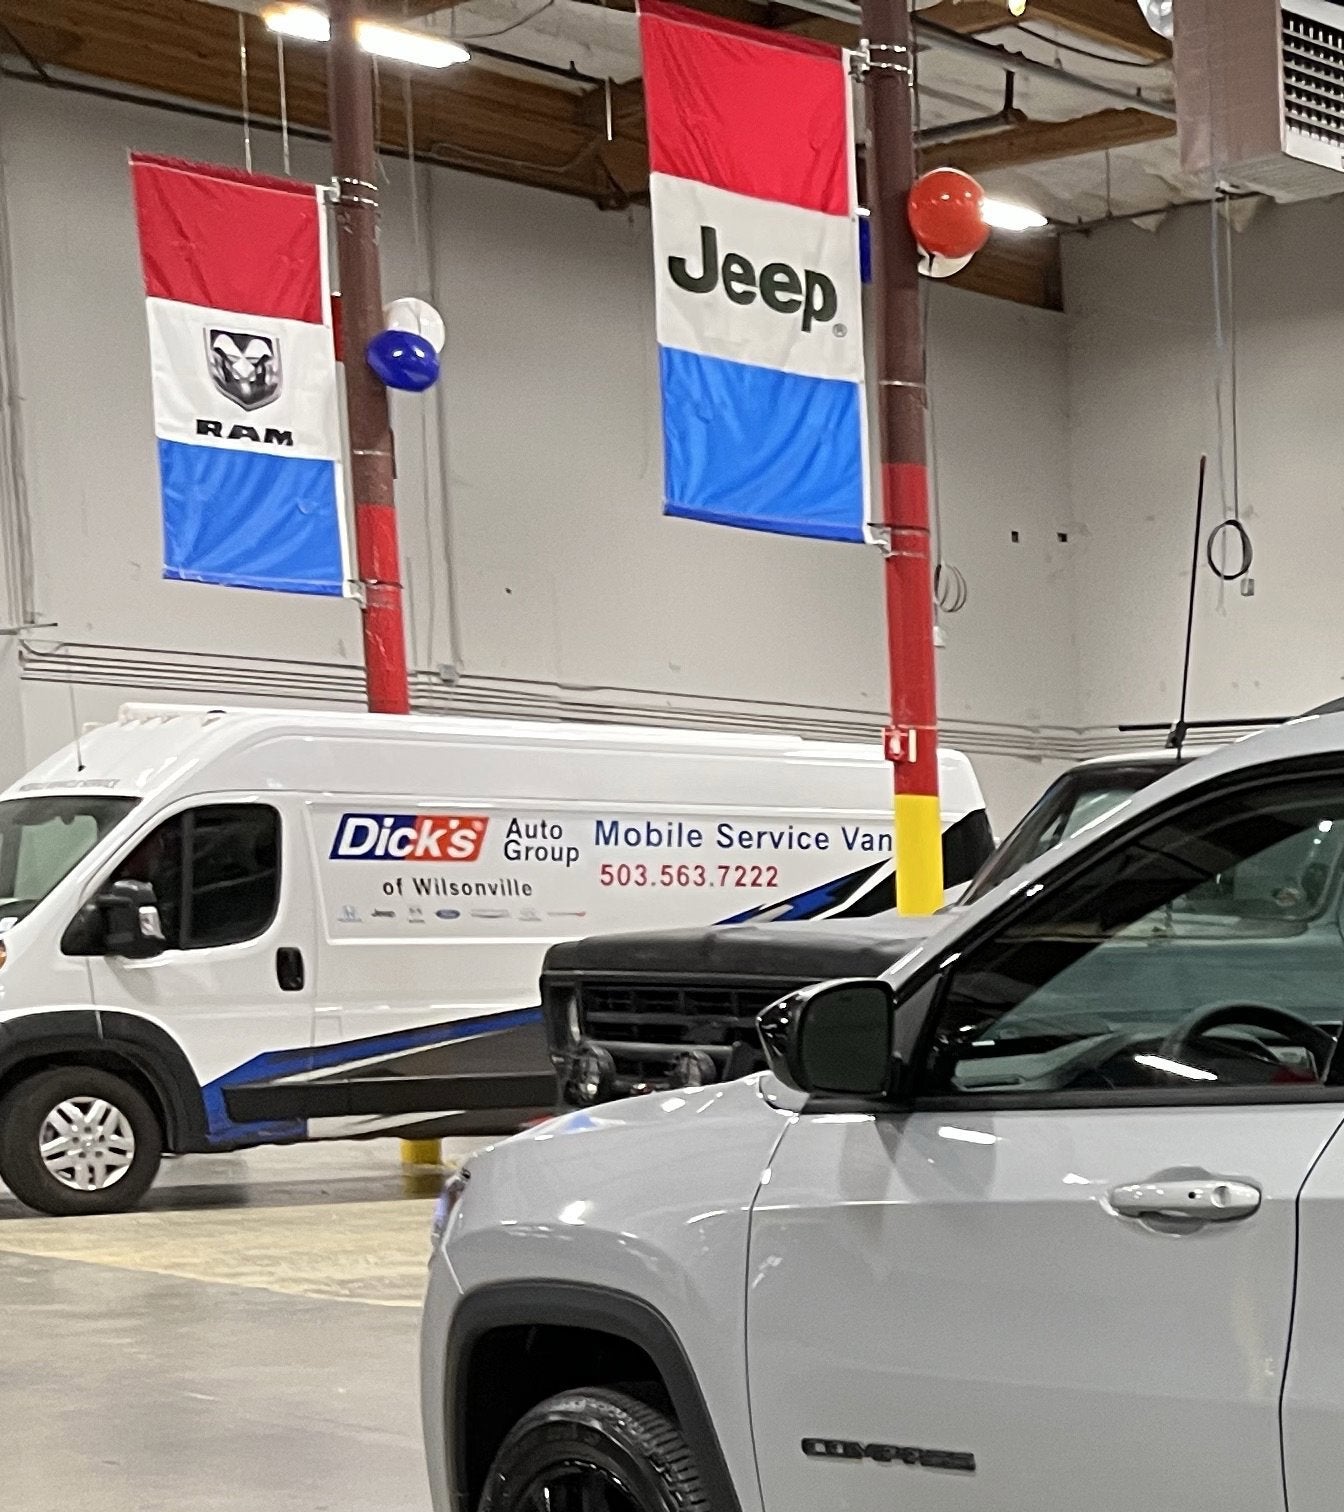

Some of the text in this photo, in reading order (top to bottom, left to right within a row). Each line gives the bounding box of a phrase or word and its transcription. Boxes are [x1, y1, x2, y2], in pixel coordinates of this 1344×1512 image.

[196, 419, 293, 446] RAM
[505, 817, 563, 840] Auto
[595, 820, 893, 851] Mobile Service Van
[503, 840, 580, 867] Group
[382, 877, 533, 897] of Wilsonville
[600, 863, 779, 888] 503.563.7222
